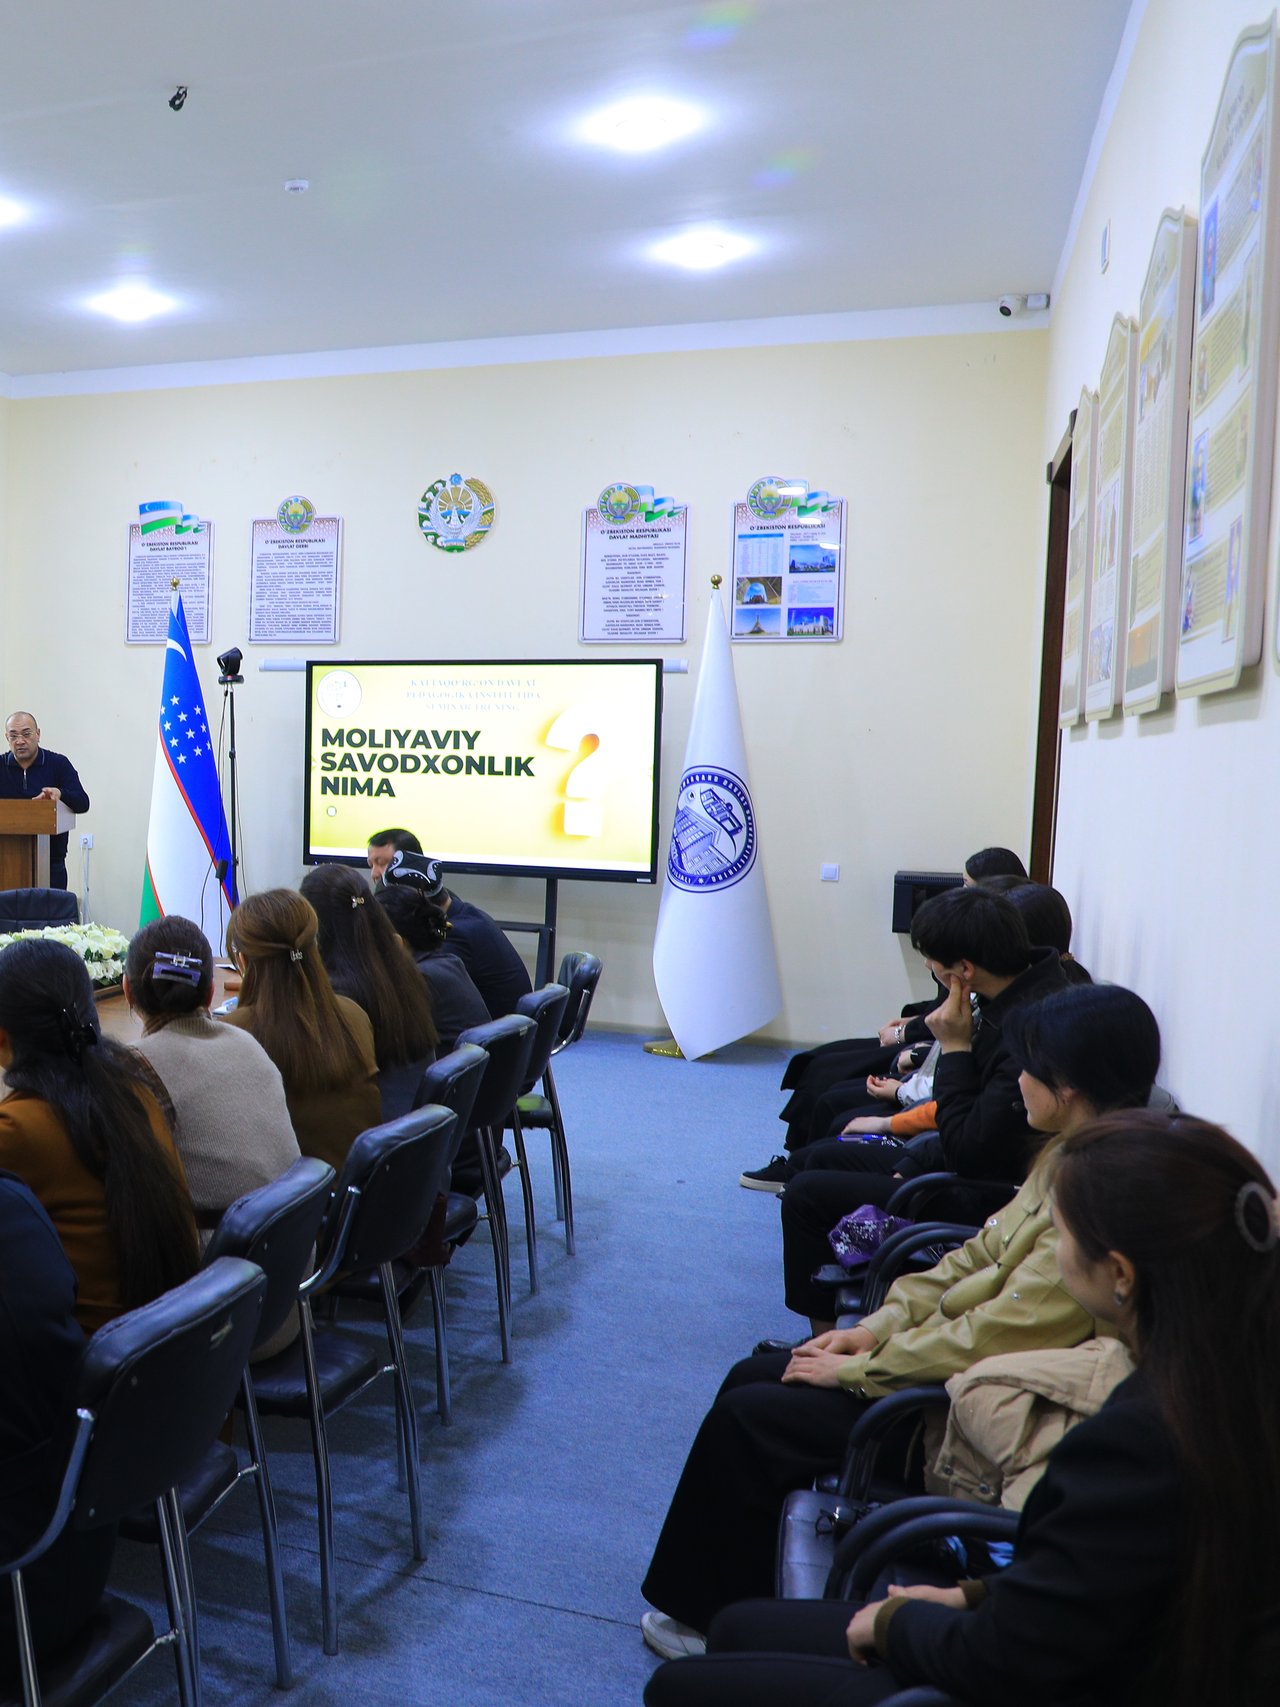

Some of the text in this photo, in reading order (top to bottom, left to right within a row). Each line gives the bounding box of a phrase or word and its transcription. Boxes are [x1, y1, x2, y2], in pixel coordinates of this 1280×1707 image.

[321, 728, 482, 750] MOLIYAVIY
[320, 752, 536, 777] SAVODXONLIK
[320, 776, 396, 797] NIMA
